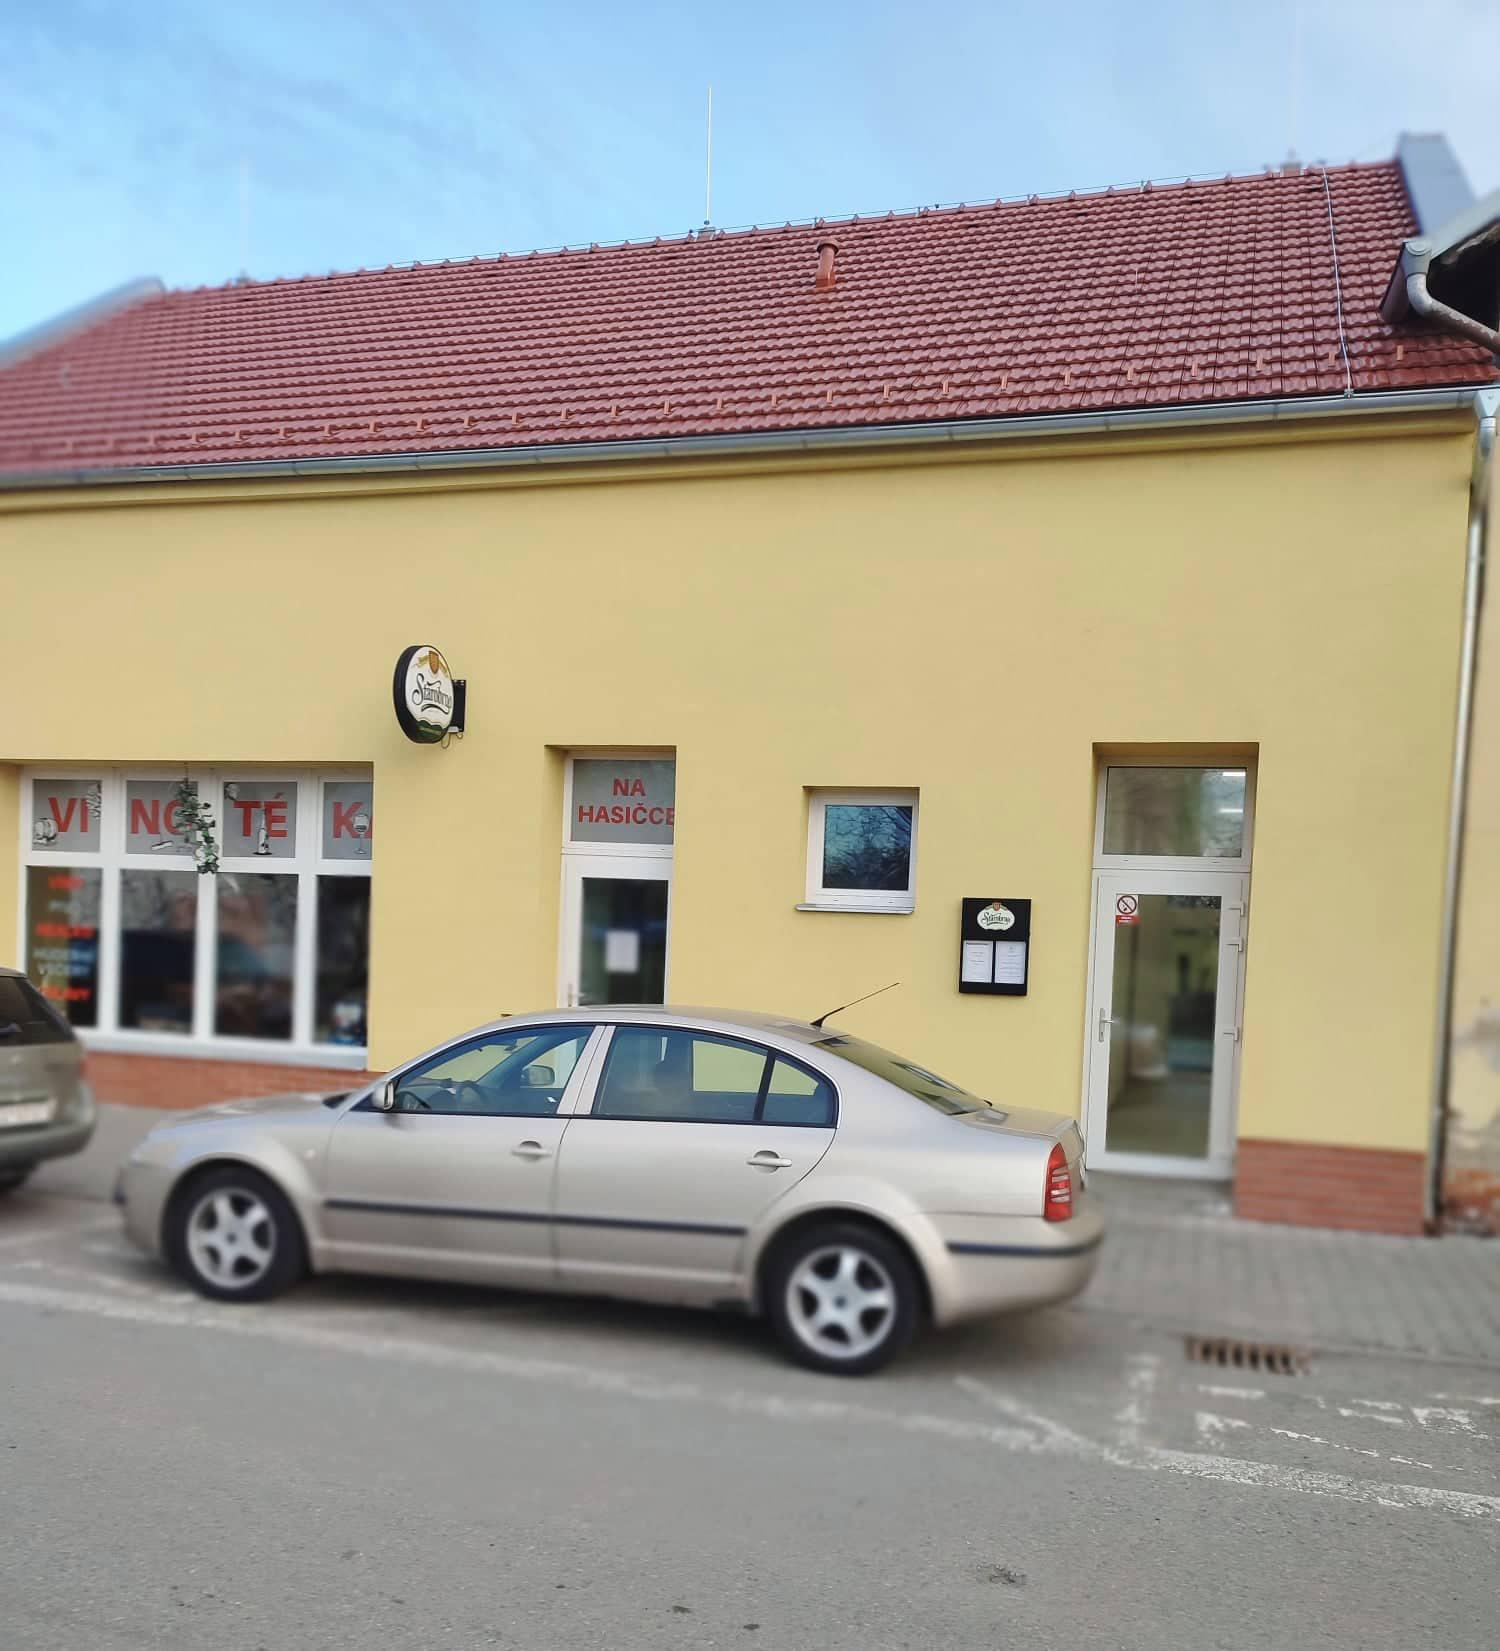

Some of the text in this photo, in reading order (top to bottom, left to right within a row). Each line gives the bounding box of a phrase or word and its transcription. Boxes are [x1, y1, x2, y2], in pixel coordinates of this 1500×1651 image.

[612, 778, 646, 797] NA
[47, 797, 89, 833] VI
[233, 791, 288, 837] TÉ
